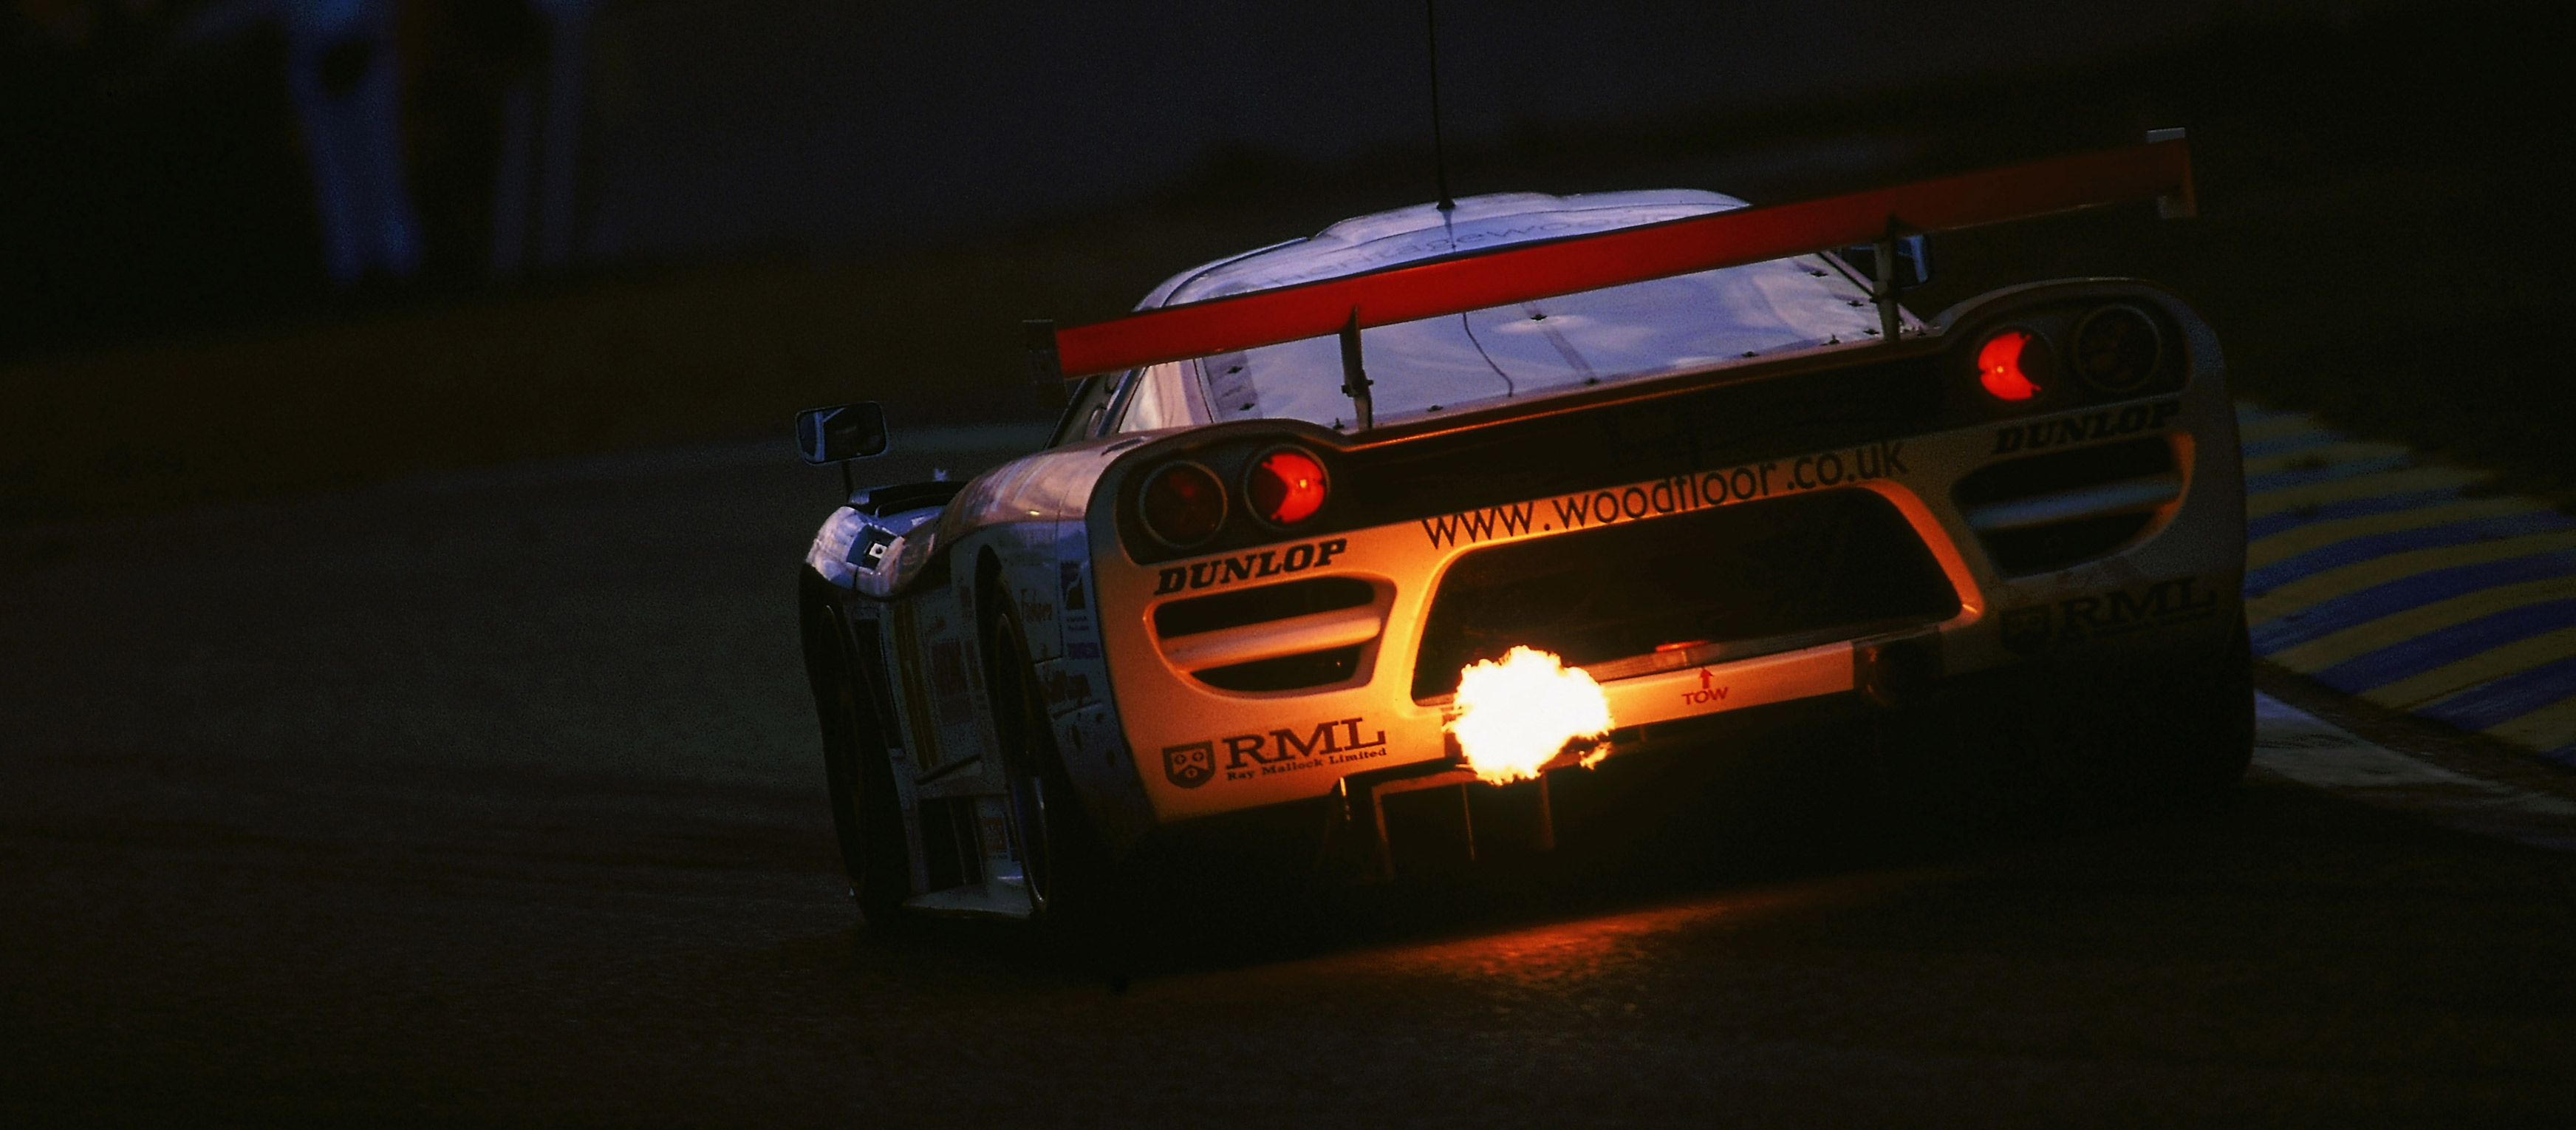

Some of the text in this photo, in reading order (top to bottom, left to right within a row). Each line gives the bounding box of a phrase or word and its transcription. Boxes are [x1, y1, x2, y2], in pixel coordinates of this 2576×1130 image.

[1995, 401, 2179, 453] DUNLOP
[1155, 540, 1347, 595] DUNLOP
[2063, 576, 2215, 631] RML
[1682, 687, 1727, 705] TOW
[1223, 718, 1386, 769] RML
[1227, 748, 1387, 780] Ray Mallock Limited
